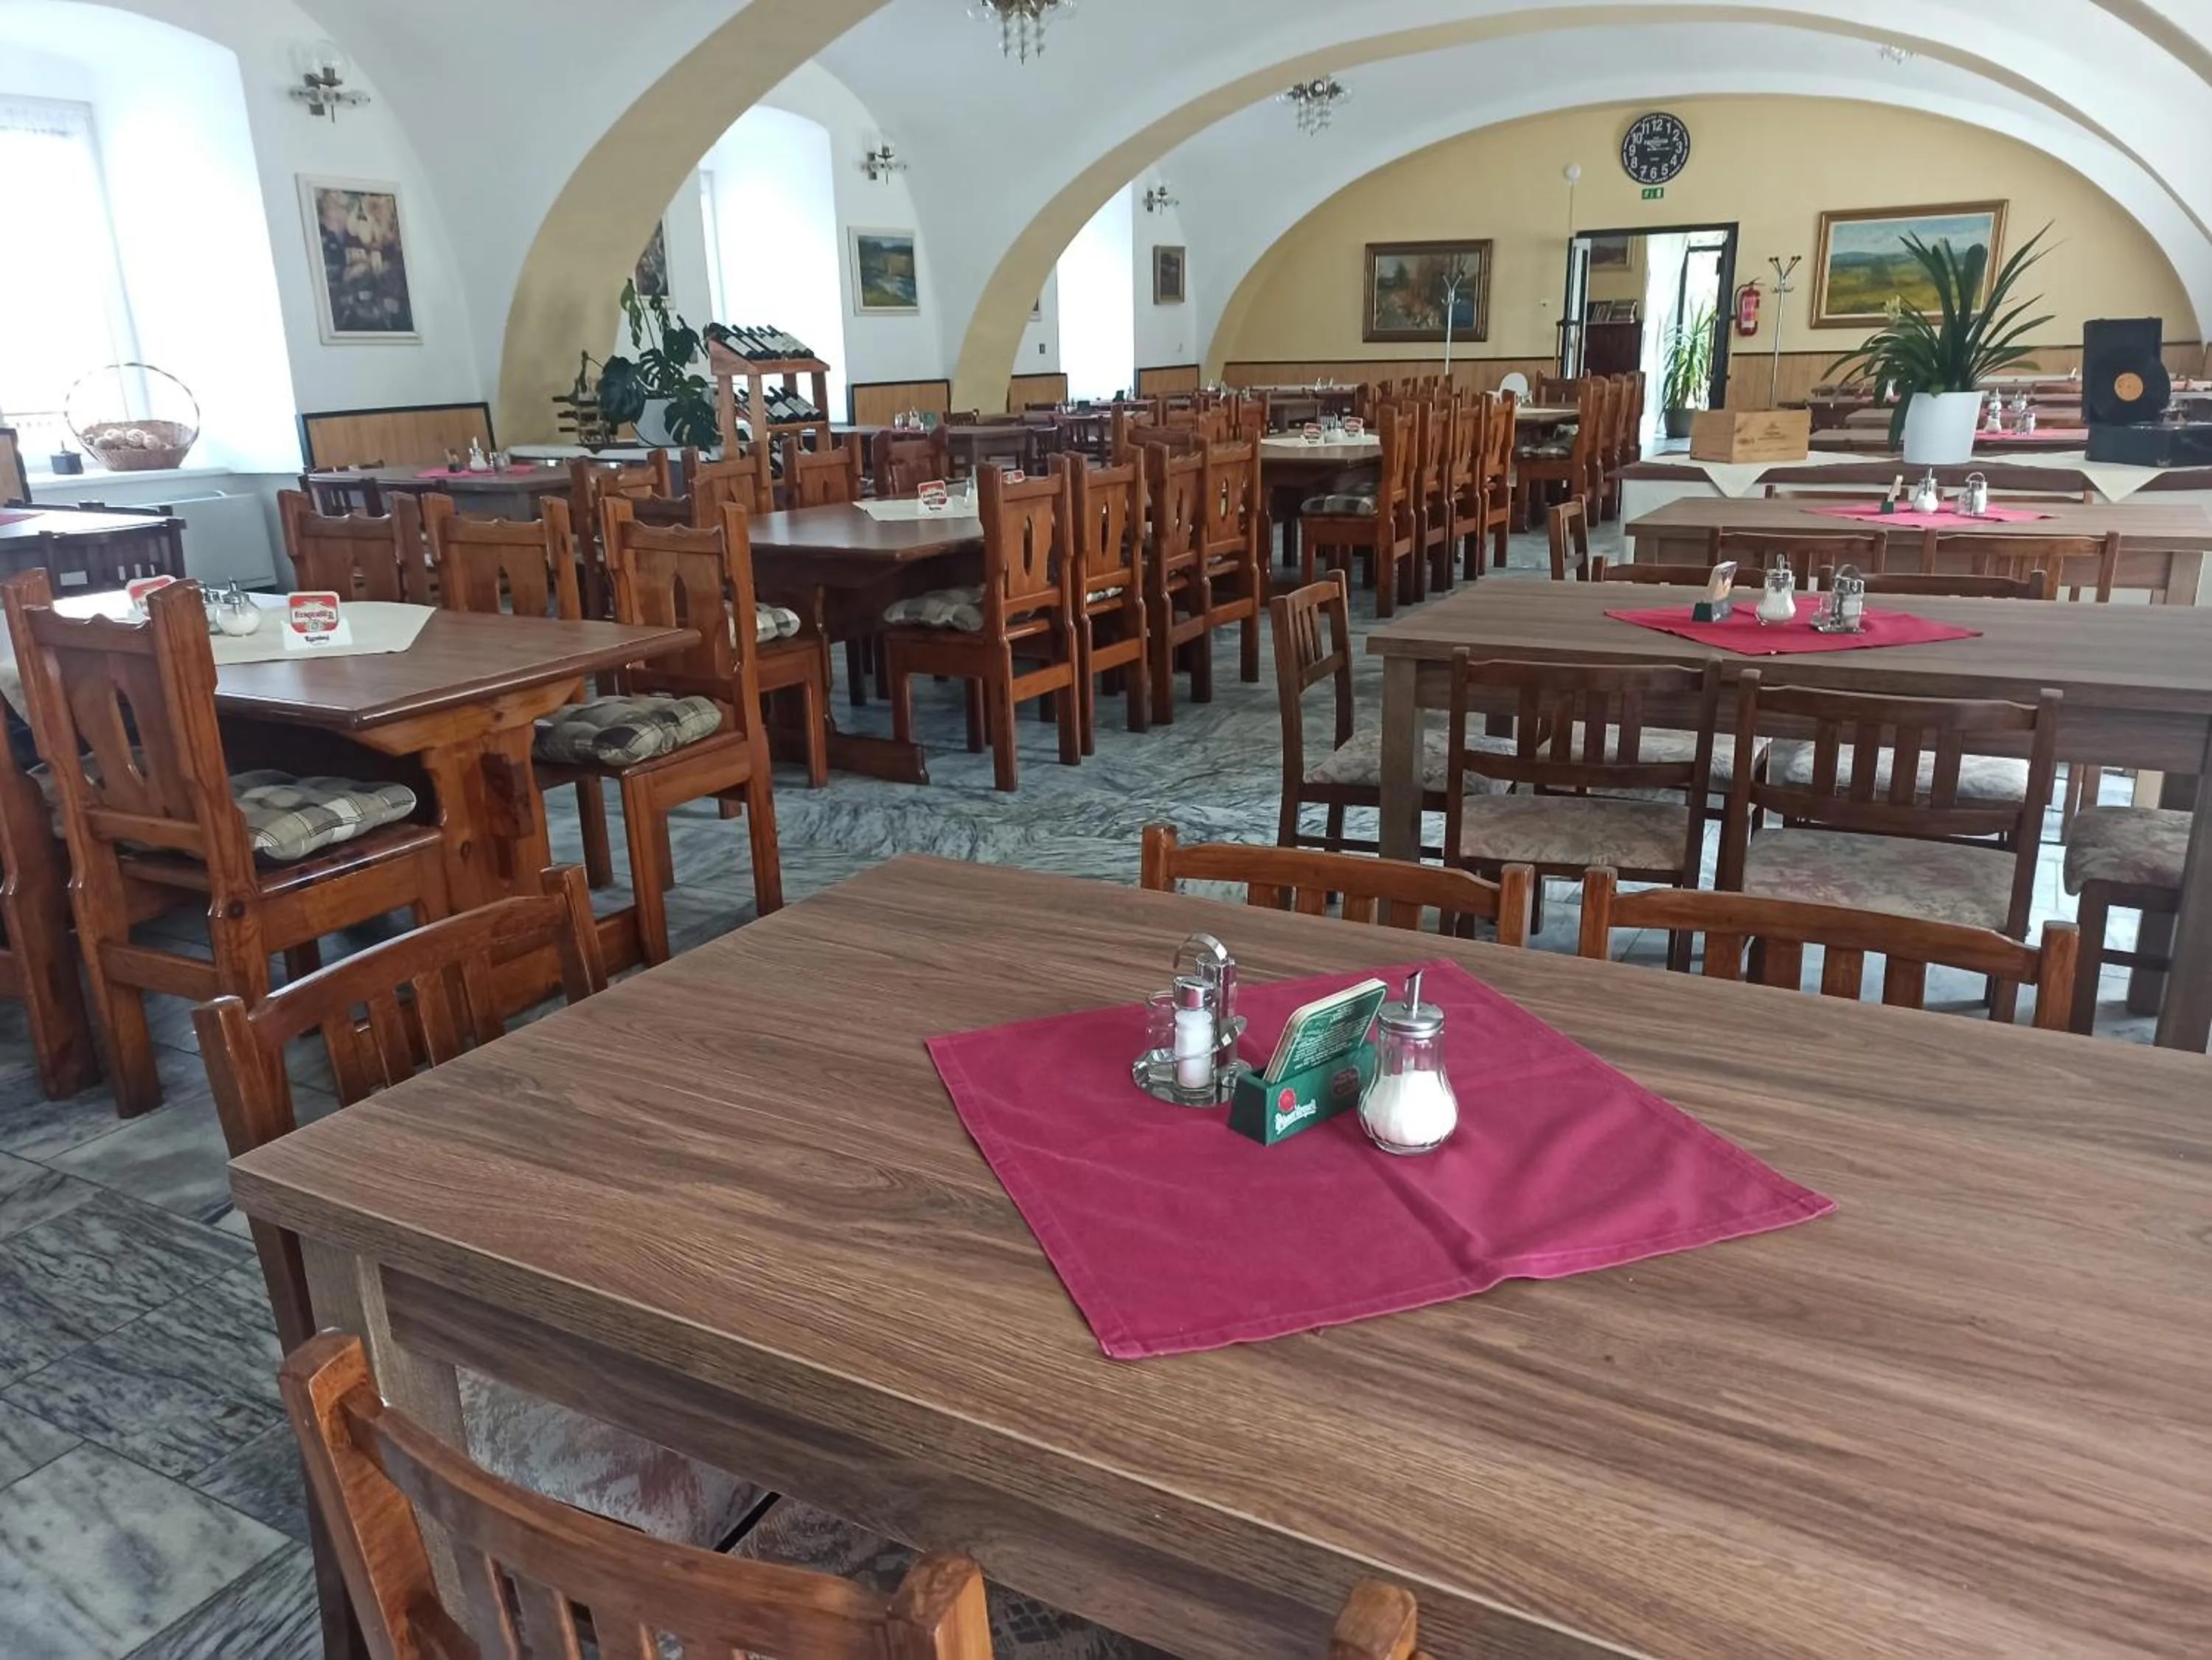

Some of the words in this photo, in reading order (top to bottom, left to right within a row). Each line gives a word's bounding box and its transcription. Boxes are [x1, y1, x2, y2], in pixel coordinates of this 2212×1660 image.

[1641, 122, 1649, 134] 11
[1652, 119, 1663, 131] 12
[1666, 122, 1672, 134] 1
[1632, 132, 1643, 144] 10
[1672, 129, 1680, 142] 2
[1629, 144, 1636, 156] 9
[1675, 141, 1683, 153] 3
[1630, 156, 1638, 169] 8
[1670, 154, 1677, 166] 4
[1639, 164, 1648, 177] 7
[1650, 167, 1658, 178] 6
[1661, 164, 1669, 176] 5
